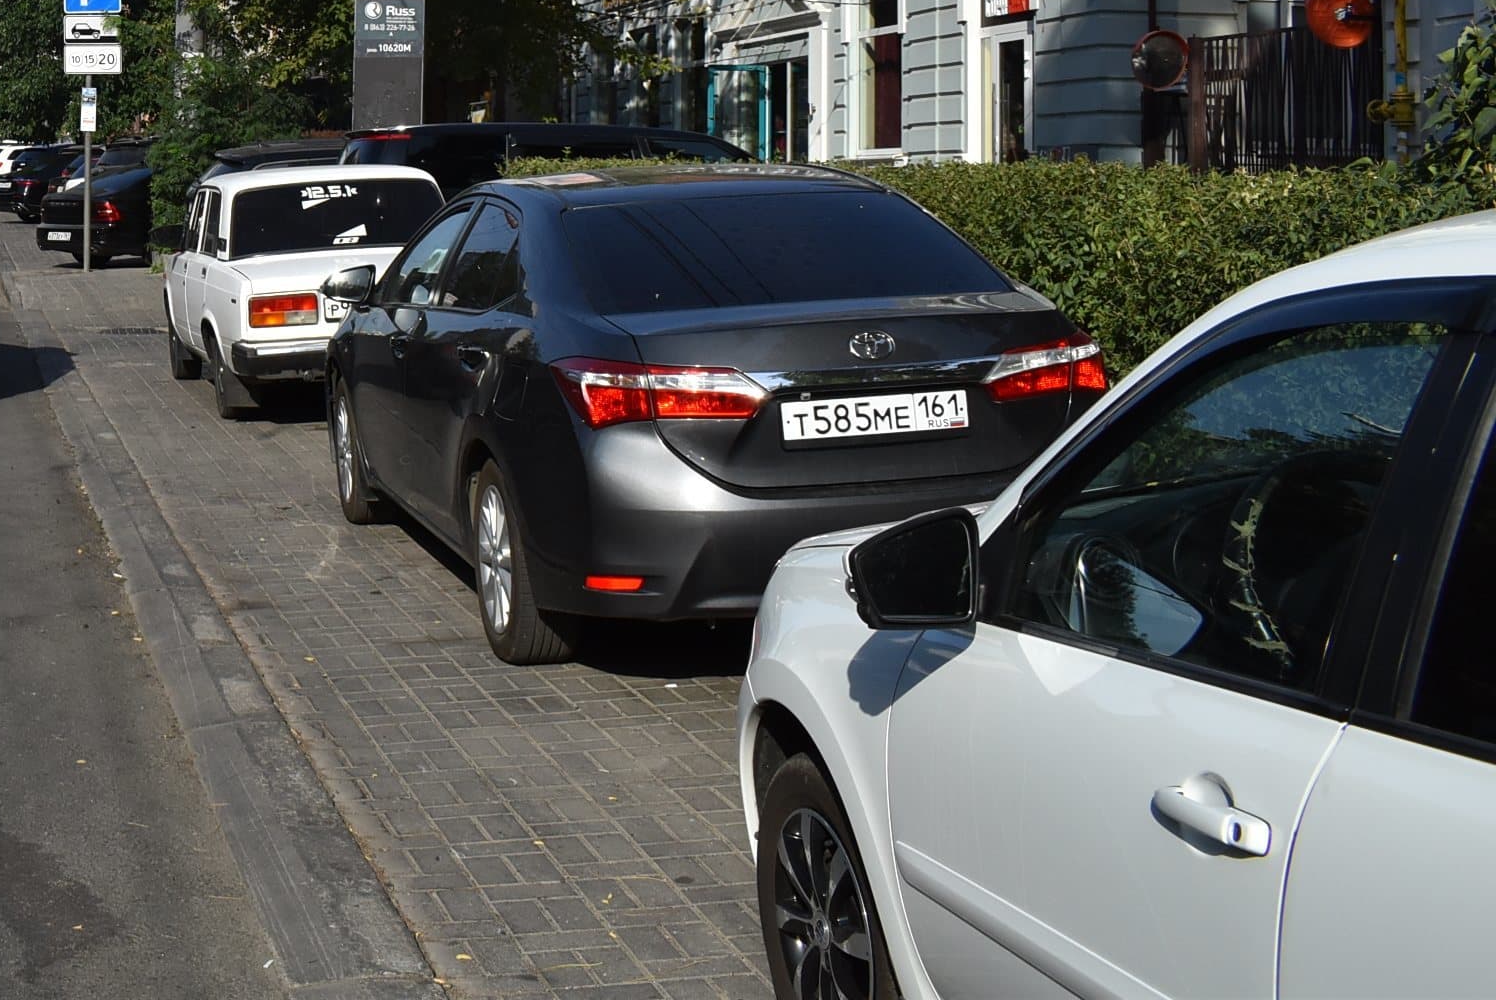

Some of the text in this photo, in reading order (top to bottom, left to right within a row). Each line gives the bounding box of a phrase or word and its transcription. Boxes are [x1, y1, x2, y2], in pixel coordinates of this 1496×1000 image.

[386, 5, 416, 16] Russ
[378, 43, 411, 52] 10620M
[71, 54, 115, 65] 10 15 20
[918, 393, 960, 419] 161
[928, 419, 950, 428] RUS
